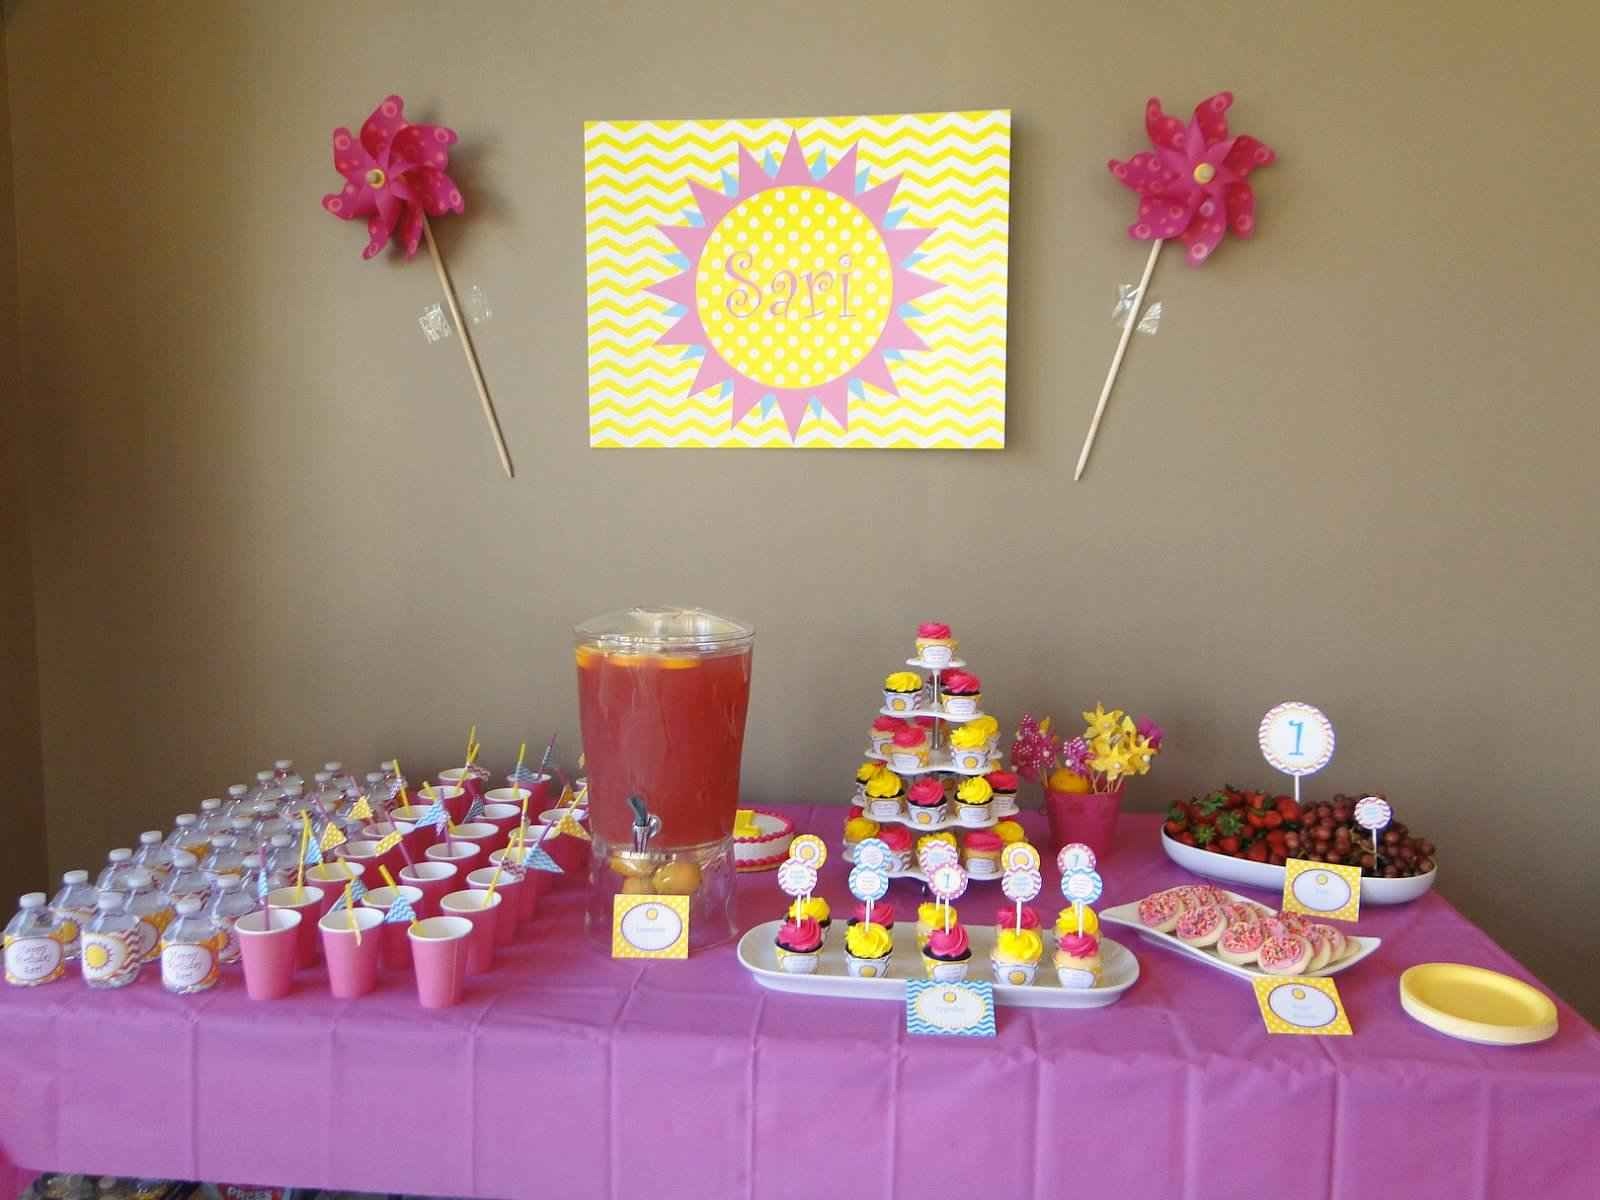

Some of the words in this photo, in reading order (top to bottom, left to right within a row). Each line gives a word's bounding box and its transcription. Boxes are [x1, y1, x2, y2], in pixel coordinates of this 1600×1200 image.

[724, 250, 857, 320] Sari
[1288, 719, 1305, 756] 1
[943, 871, 951, 889] 1
